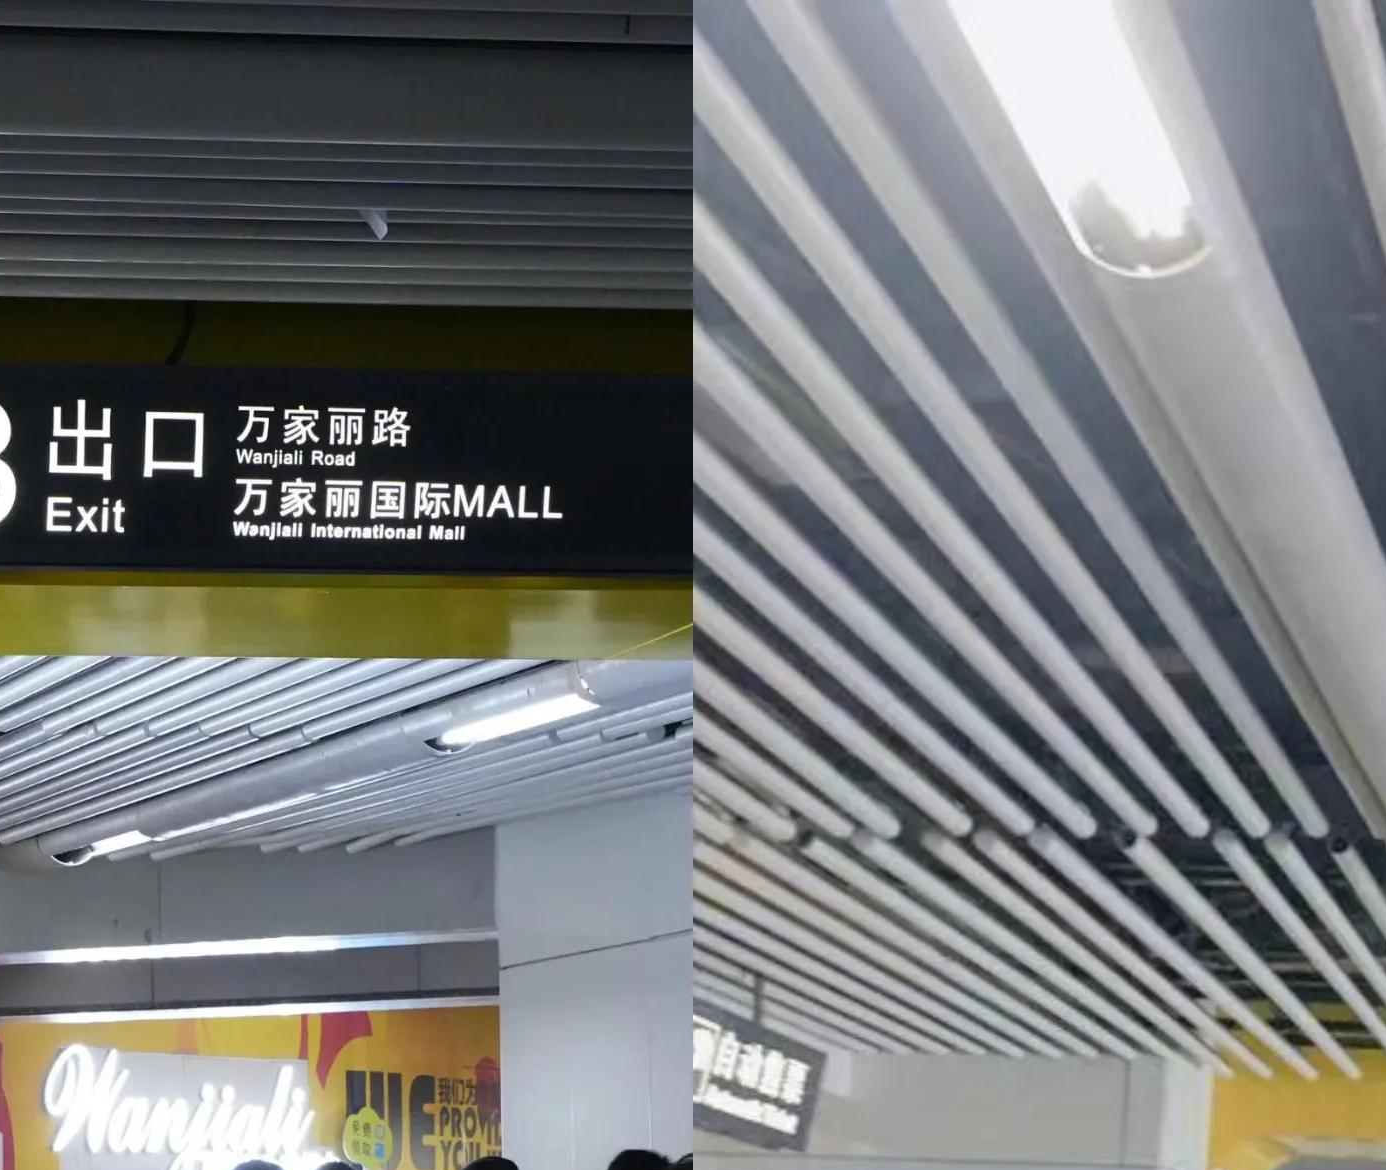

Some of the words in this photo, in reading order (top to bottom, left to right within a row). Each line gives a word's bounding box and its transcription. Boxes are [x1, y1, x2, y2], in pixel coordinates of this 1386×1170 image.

[48, 398, 205, 481] 出口
[236, 404, 411, 448] 万家丽路
[236, 448, 303, 468] Wanjiali
[311, 450, 356, 467] Road
[46, 496, 126, 534] Exit
[233, 477, 563, 519] 万家丽国际MALL
[232, 520, 303, 541] Wanjiali
[311, 523, 422, 540] International
[429, 525, 465, 540] Mall
